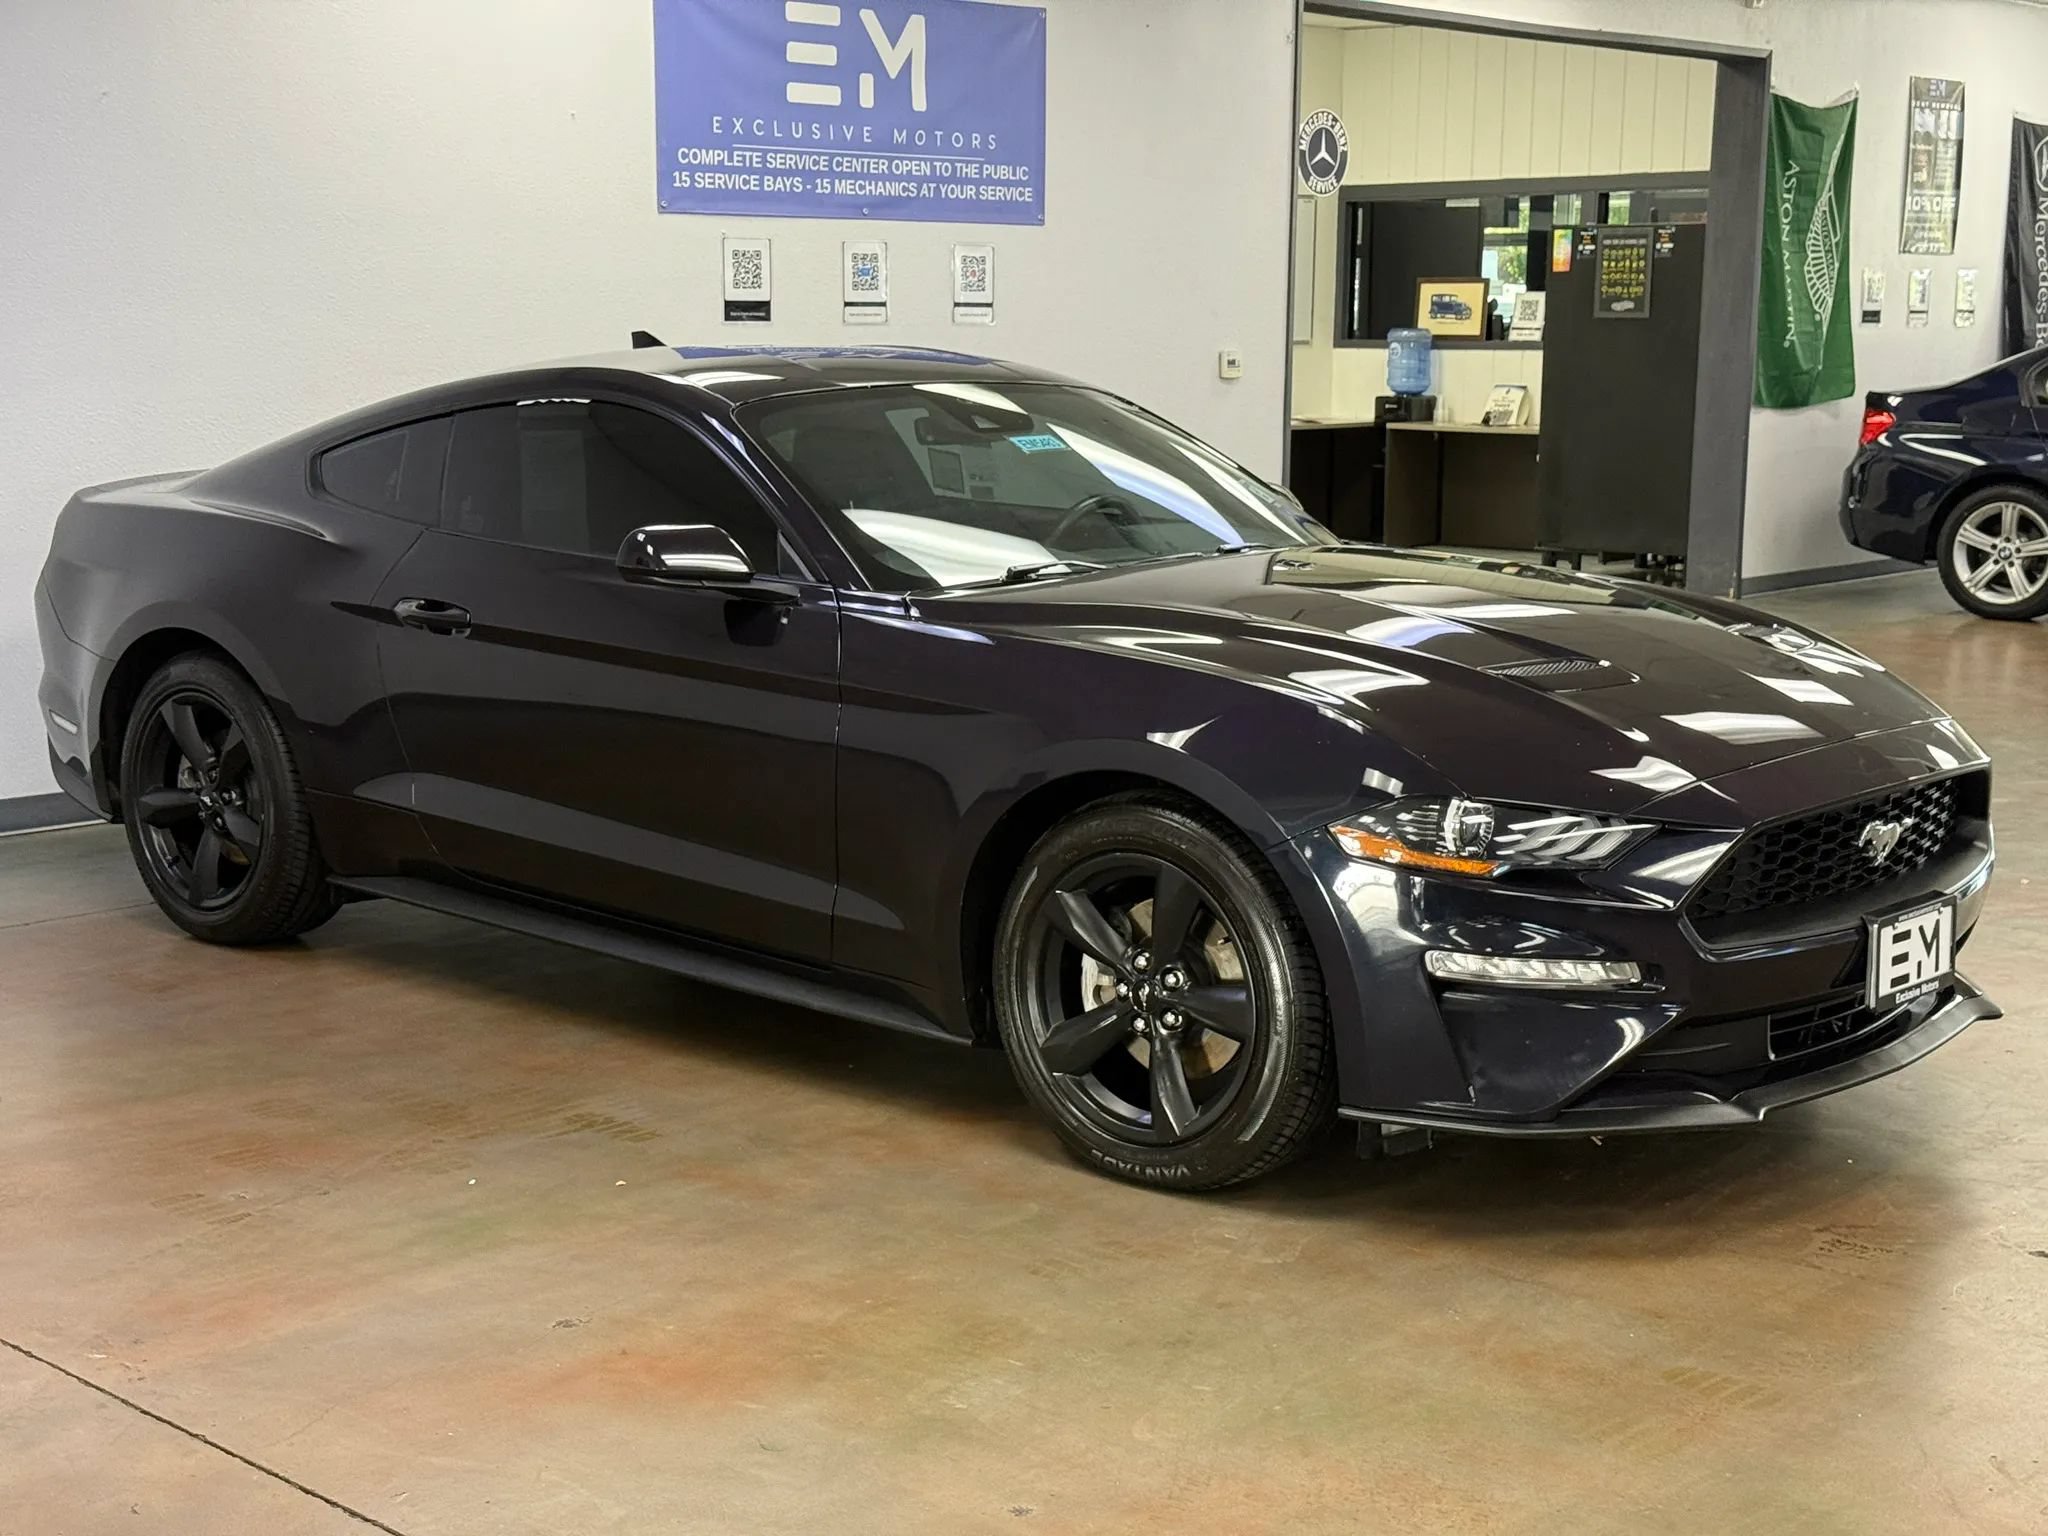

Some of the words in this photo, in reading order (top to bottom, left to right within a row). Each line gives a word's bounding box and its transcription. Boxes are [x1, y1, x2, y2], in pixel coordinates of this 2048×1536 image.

[785, 1, 927, 112] EM
[713, 116, 872, 143] EXCLUSIVE
[893, 128, 996, 150] MOTORS
[1299, 112, 1347, 152] MERCEDES-BENZ
[677, 147, 763, 168] COMPLETE
[766, 152, 829, 171] SERVICE
[832, 156, 889, 175] CENTER
[892, 159, 930, 176] OPEN
[933, 161, 952, 178] TO
[955, 162, 980, 179] THE
[983, 164, 1029, 181] PUBLIC
[672, 171, 691, 187] 15
[694, 172, 760, 190] SERVICE
[763, 175, 803, 193] BAYS
[815, 178, 831, 194] 15
[834, 179, 918, 197] MECHANICS
[920, 182, 937, 198] AT
[939, 183, 976, 200] YOUR
[979, 186, 1033, 202] SERVICE
[1308, 175, 1338, 194] SERVICE
[1781, 160, 1800, 242] ASTON
[1890, 918, 1940, 989] EM
